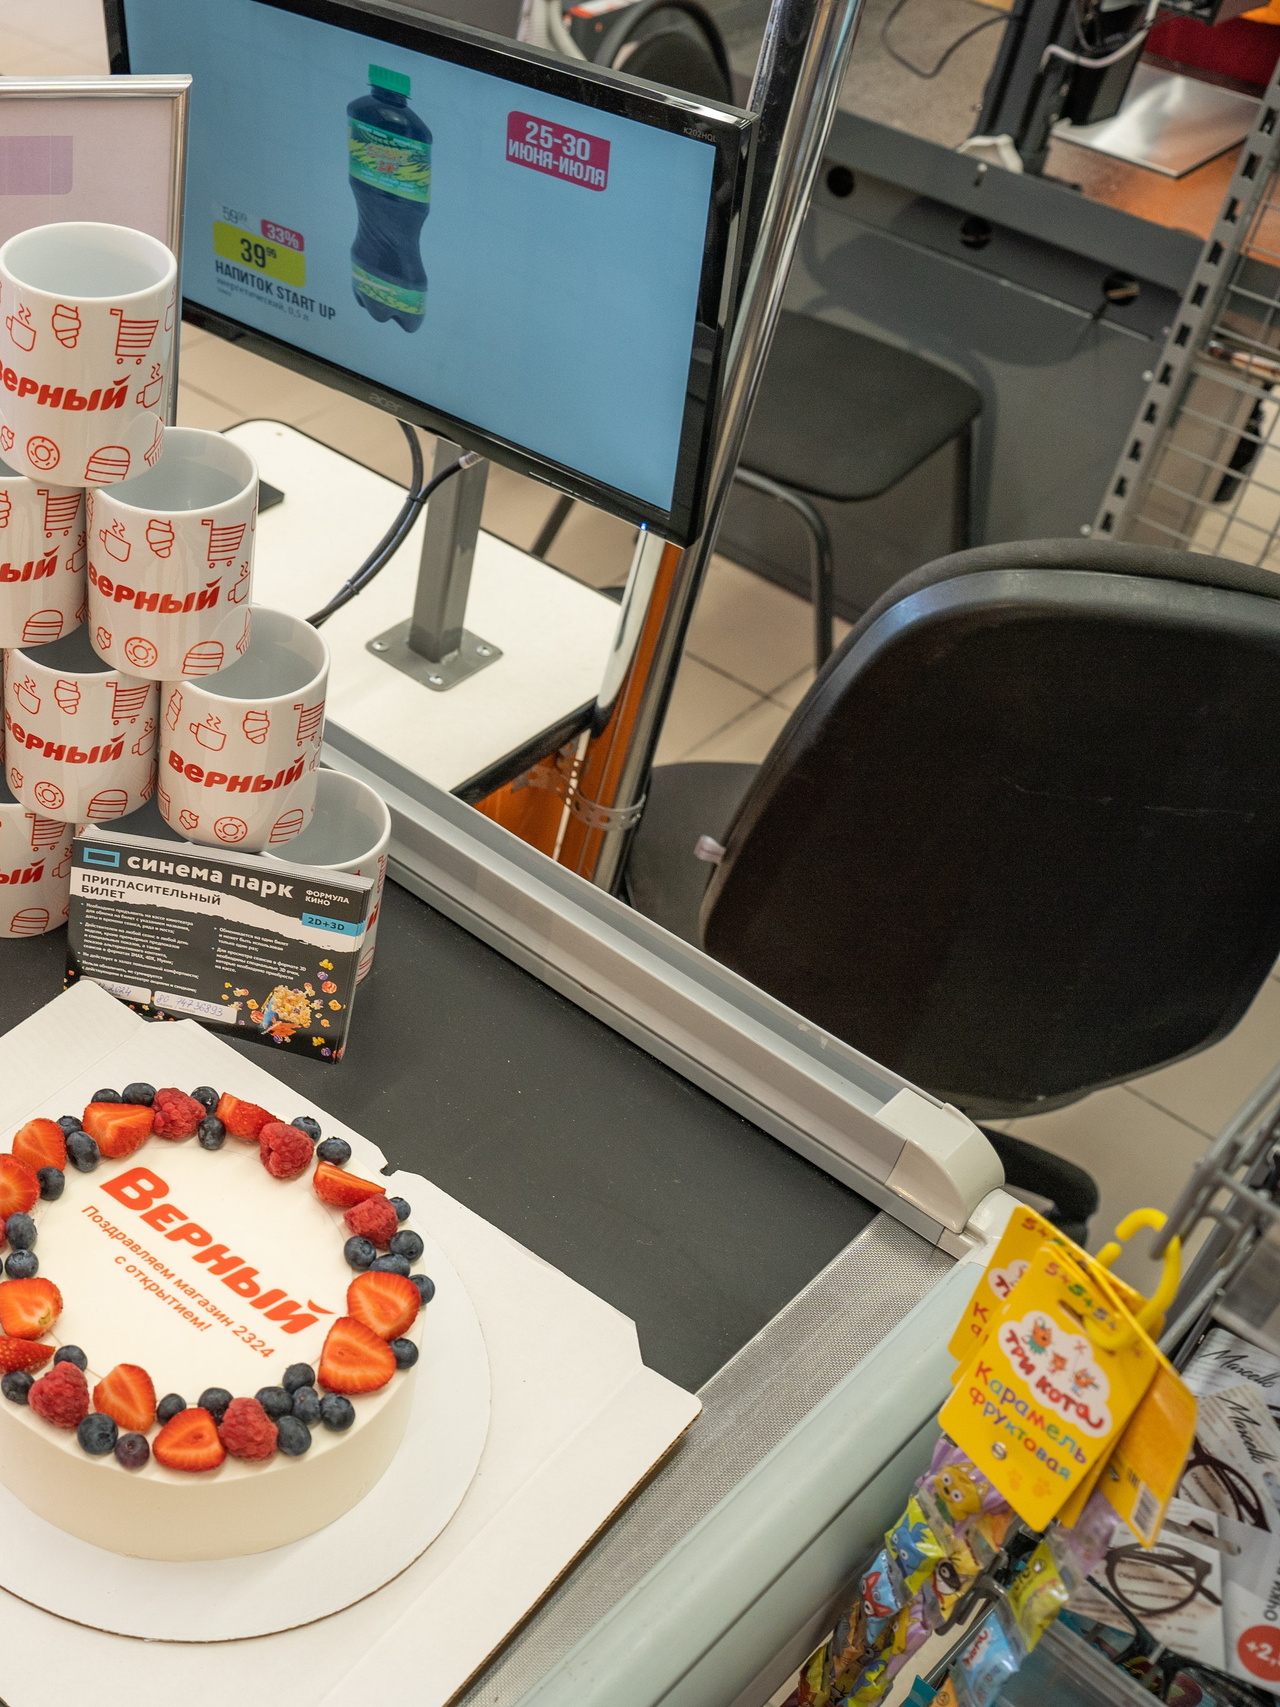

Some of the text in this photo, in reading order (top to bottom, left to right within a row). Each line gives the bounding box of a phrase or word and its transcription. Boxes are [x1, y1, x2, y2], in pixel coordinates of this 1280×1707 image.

[525, 121, 590, 161] 25-30
[508, 139, 606, 188] ИЮНЯ-ИЮЛЯ
[266, 224, 299, 249] 33%
[215, 260, 336, 320] НАПИТОК START UP
[168, 749, 306, 794] верный
[81, 884, 126, 900] БИЛЕТ
[82, 873, 221, 906] ПРИГЛАСИТЕЛЬНЫЙ
[127, 854, 294, 900] синема парк
[305, 889, 350, 905] ФОРМУЛА
[305, 896, 331, 907] КИНО
[307, 916, 346, 932] 2D+3D
[81, 1205, 275, 1358] Поздравляем магазин 2324
[114, 1255, 212, 1332] с открытием!
[1198, 1349, 1280, 1389] Marcello
[974, 1361, 1088, 1465] Карамель
[1216, 1395, 1278, 1464] Marcello
